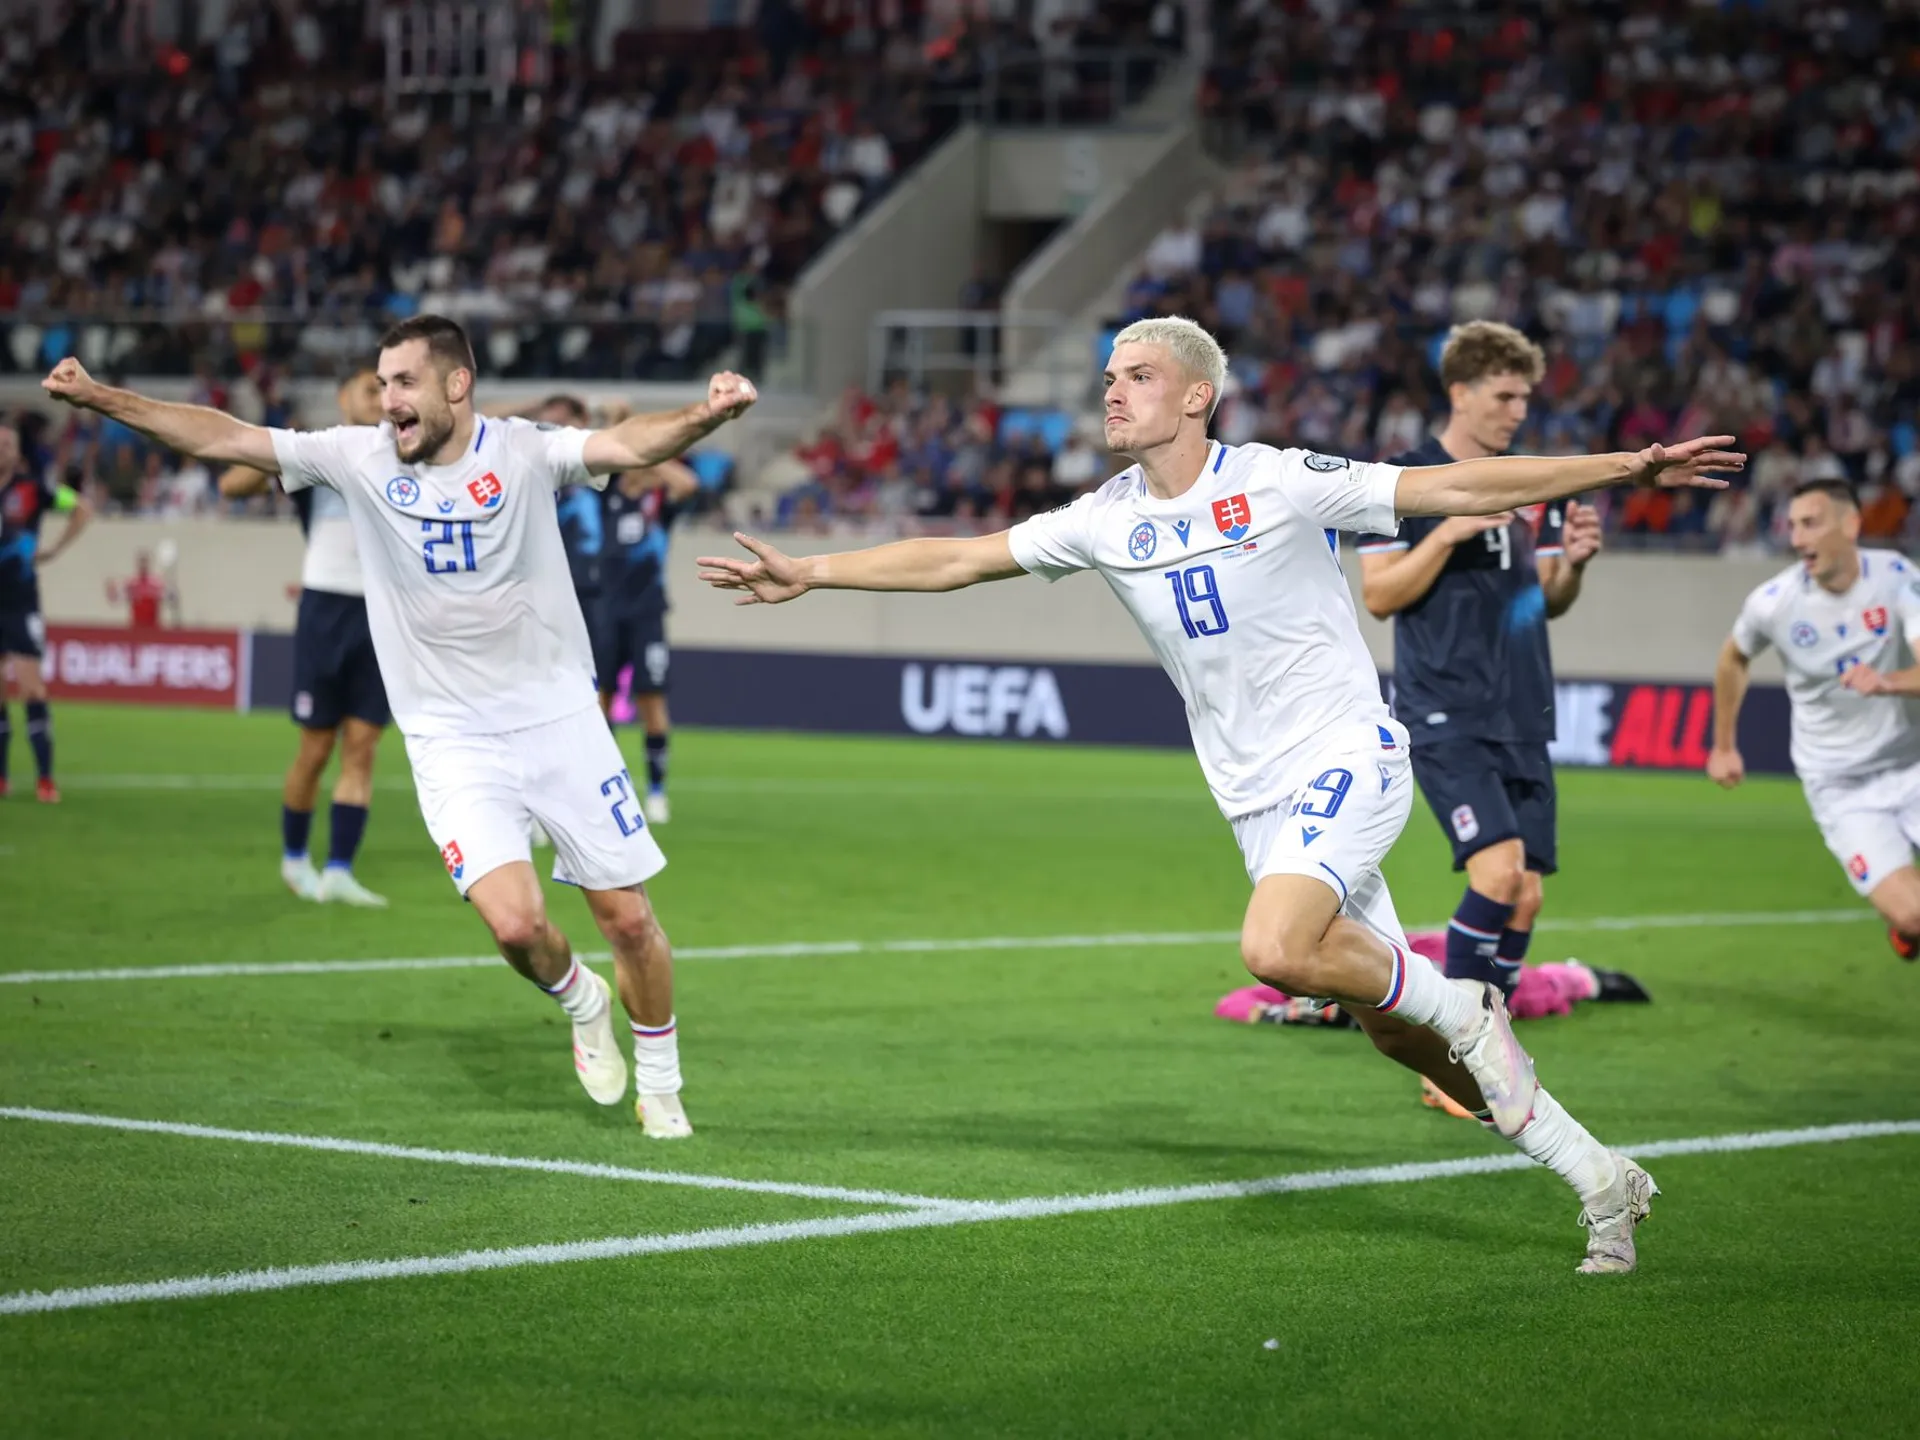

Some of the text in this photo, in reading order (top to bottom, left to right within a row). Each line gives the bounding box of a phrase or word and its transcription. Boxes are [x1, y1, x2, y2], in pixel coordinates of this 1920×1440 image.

[421, 518, 477, 574] 21
[1165, 564, 1230, 639] 19
[60, 640, 233, 690] QUALIFIERS
[902, 663, 1069, 739] UEFA
[1610, 684, 1713, 768] ALL
